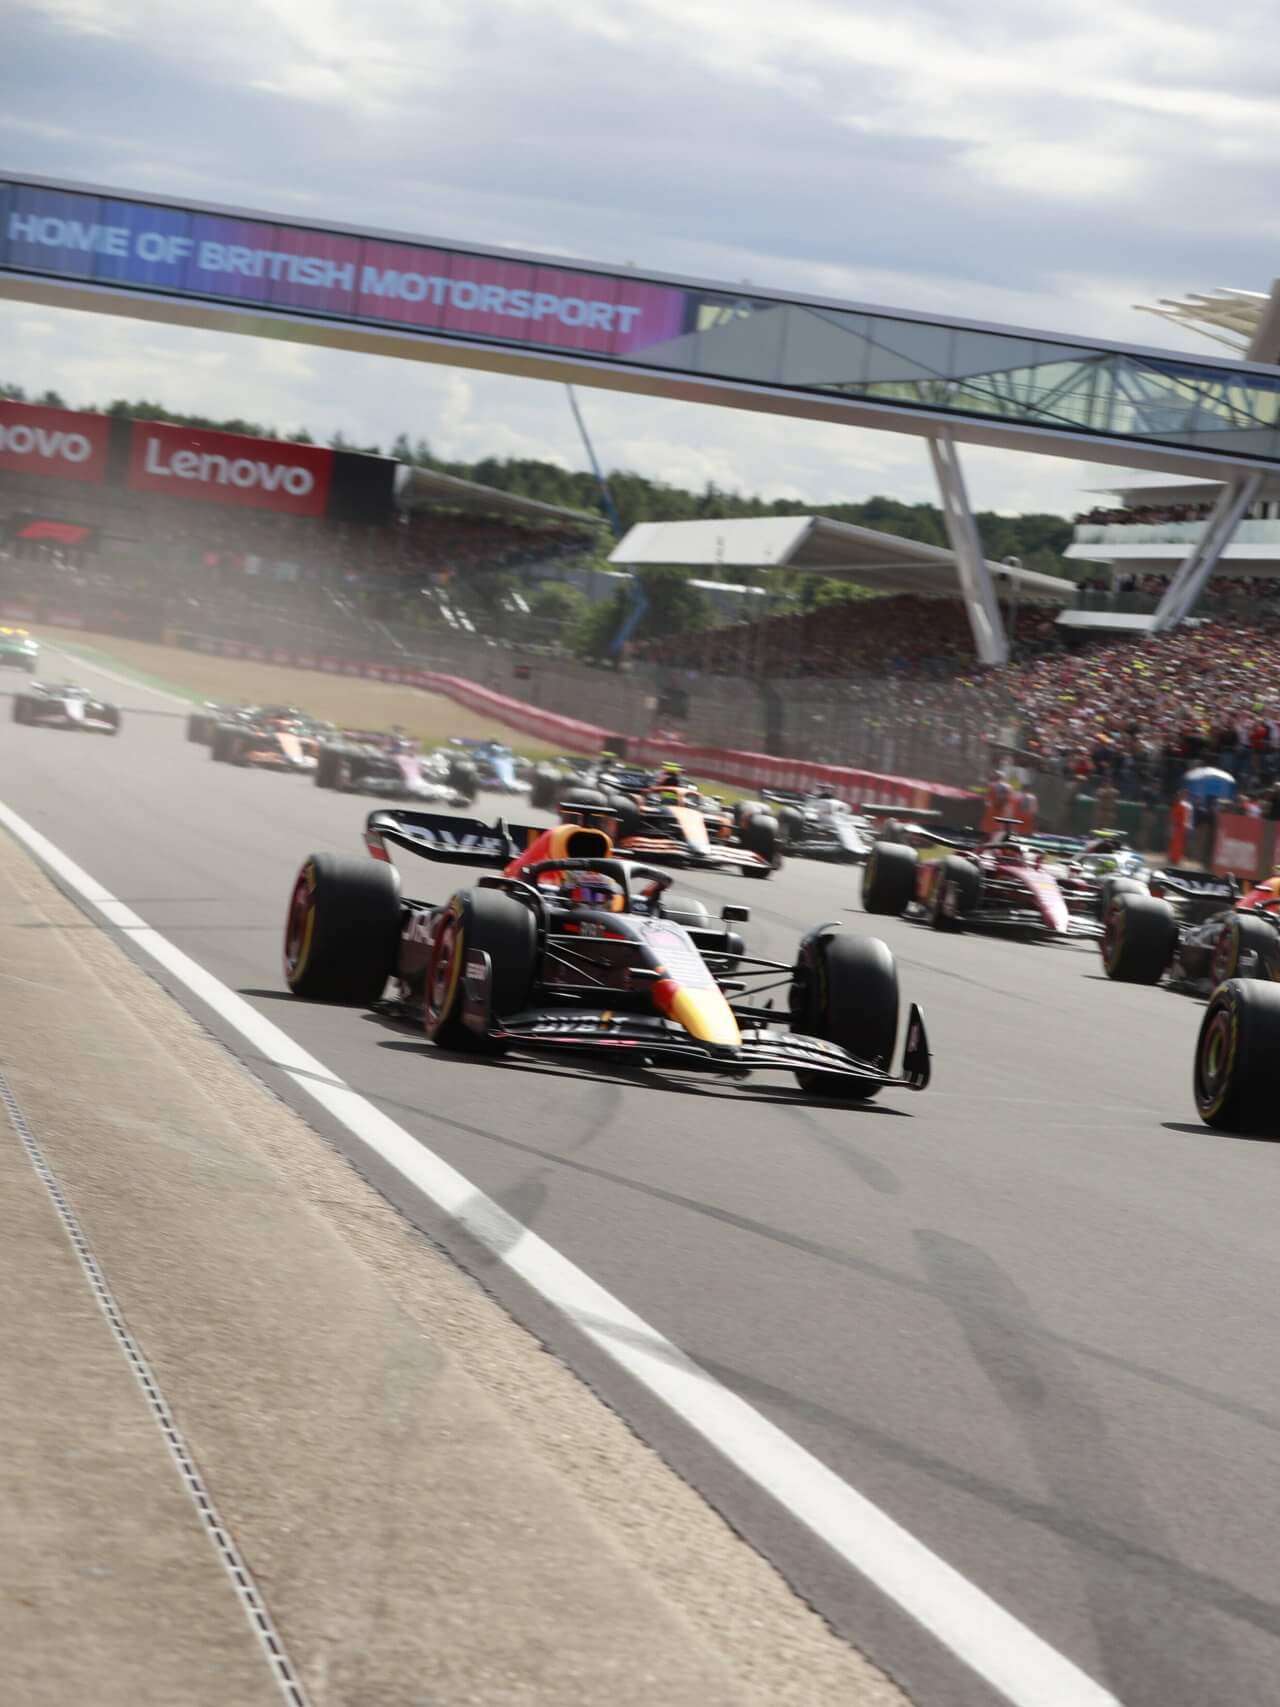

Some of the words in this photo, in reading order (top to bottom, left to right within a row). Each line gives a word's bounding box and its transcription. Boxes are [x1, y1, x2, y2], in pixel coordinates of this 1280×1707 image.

[7, 212, 130, 257] HOME
[135, 231, 195, 265] OF
[197, 241, 356, 291] BRITISH
[360, 265, 641, 333] MOTORSPORT
[144, 437, 314, 496] Lenovo
